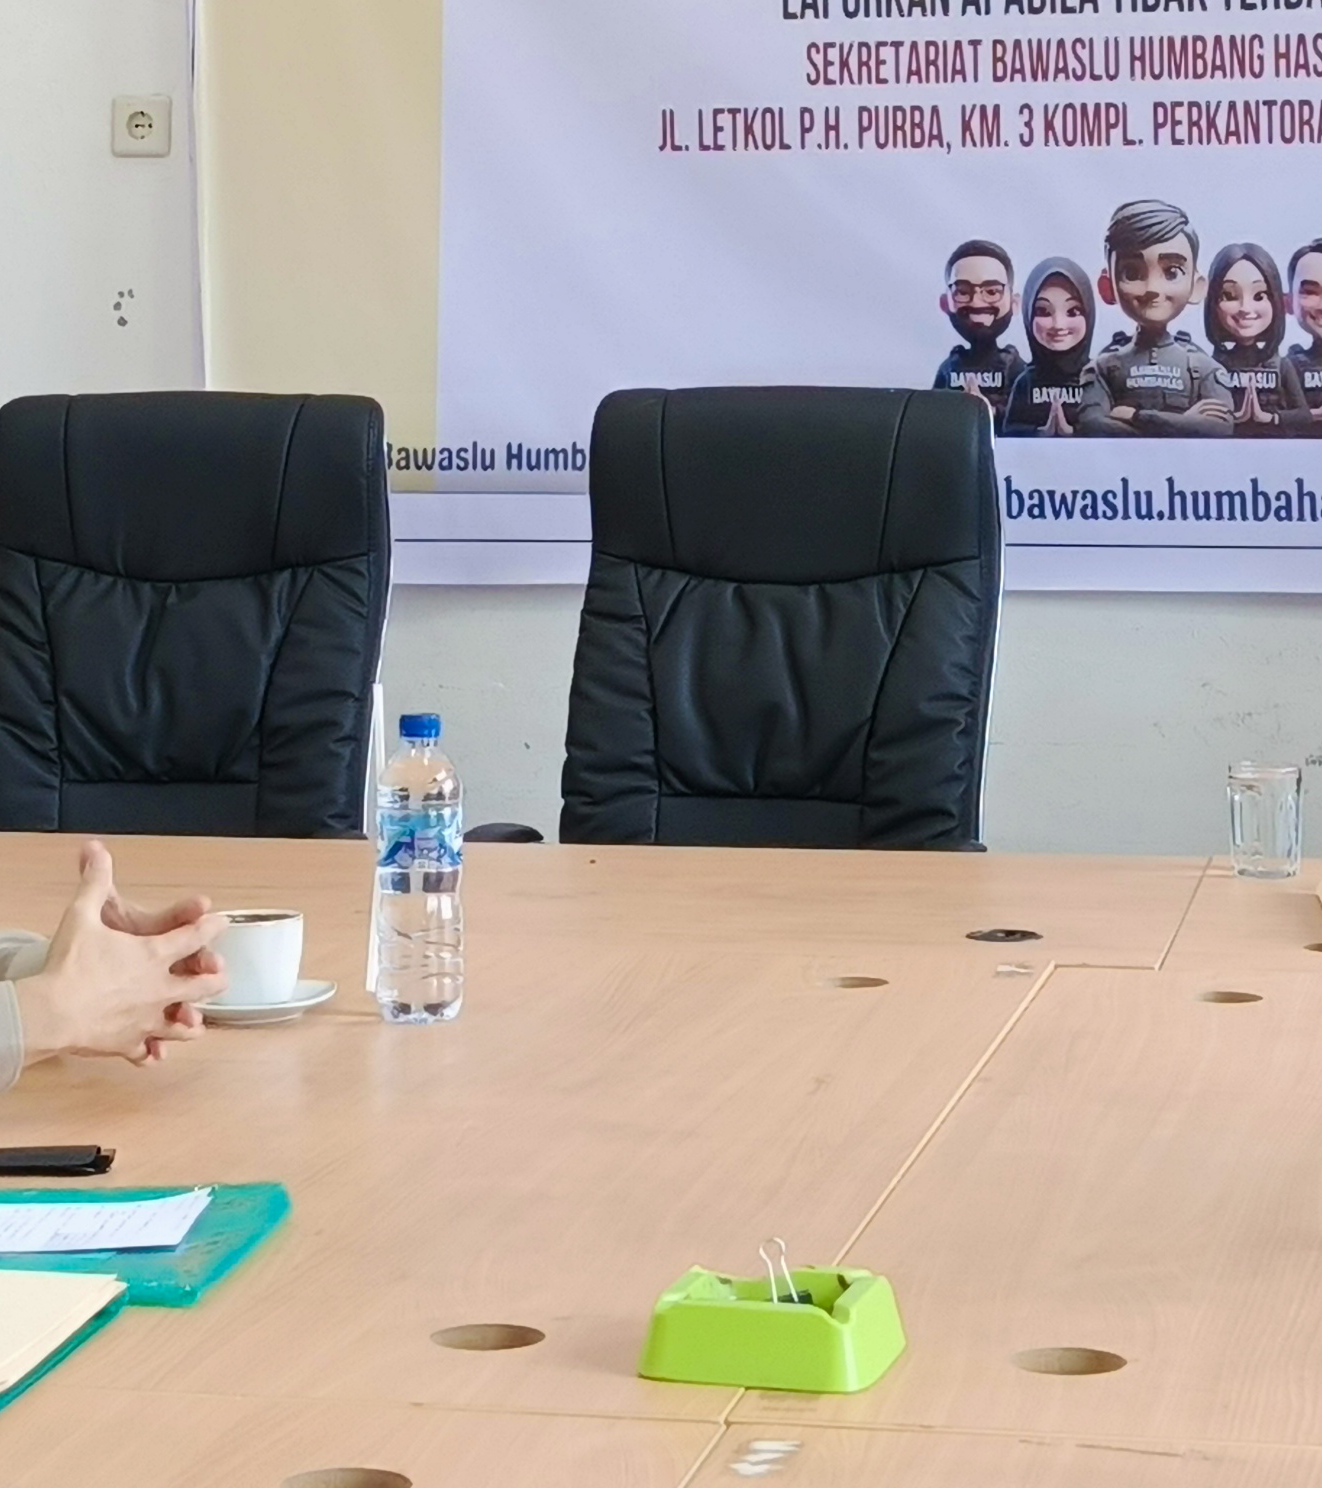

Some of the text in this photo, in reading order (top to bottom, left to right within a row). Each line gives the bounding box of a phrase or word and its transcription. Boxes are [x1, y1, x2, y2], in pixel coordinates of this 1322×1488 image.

[805, 38, 982, 86] SEKRETARIAT
[992, 35, 1120, 84] BAWASLU
[1130, 33, 1264, 81] HUMBANG
[658, 108, 690, 152] JL.
[698, 106, 791, 152] LETKOL
[800, 106, 848, 151] P.H.
[858, 104, 952, 154] PURBA,
[960, 103, 1009, 149] KM.
[1018, 103, 1035, 148] 3
[1044, 101, 1144, 148] KOMPL.
[506, 441, 587, 471] Humb
